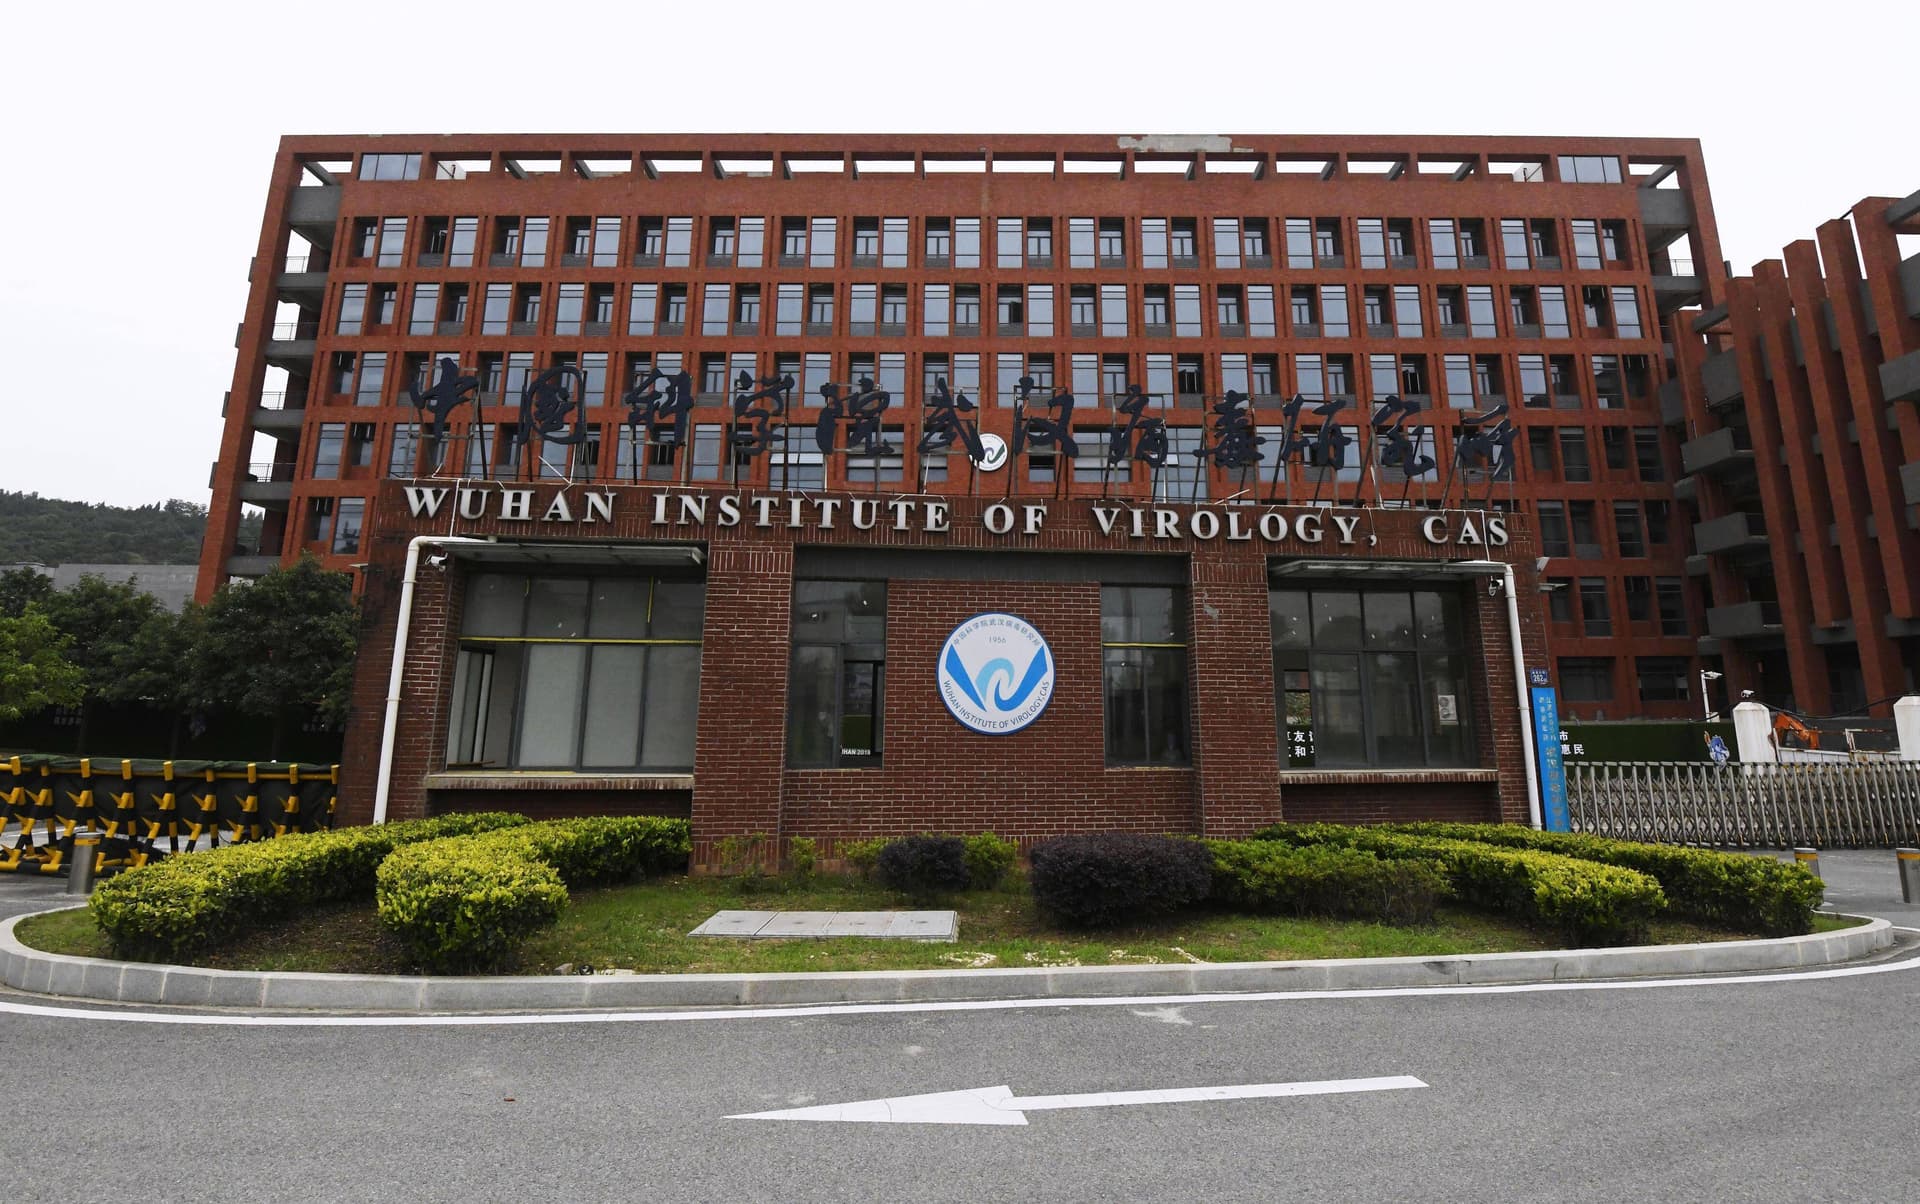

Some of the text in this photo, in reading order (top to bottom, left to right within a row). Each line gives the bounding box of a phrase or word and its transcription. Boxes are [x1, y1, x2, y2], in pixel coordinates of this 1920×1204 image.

[403, 487, 1509, 546] WUHAN INSTITUTE OF VIROLOGY, CAS
[943, 680, 961, 709] WUHAN
[959, 708, 997, 728] INSTITUTE
[998, 720, 1009, 728] OF
